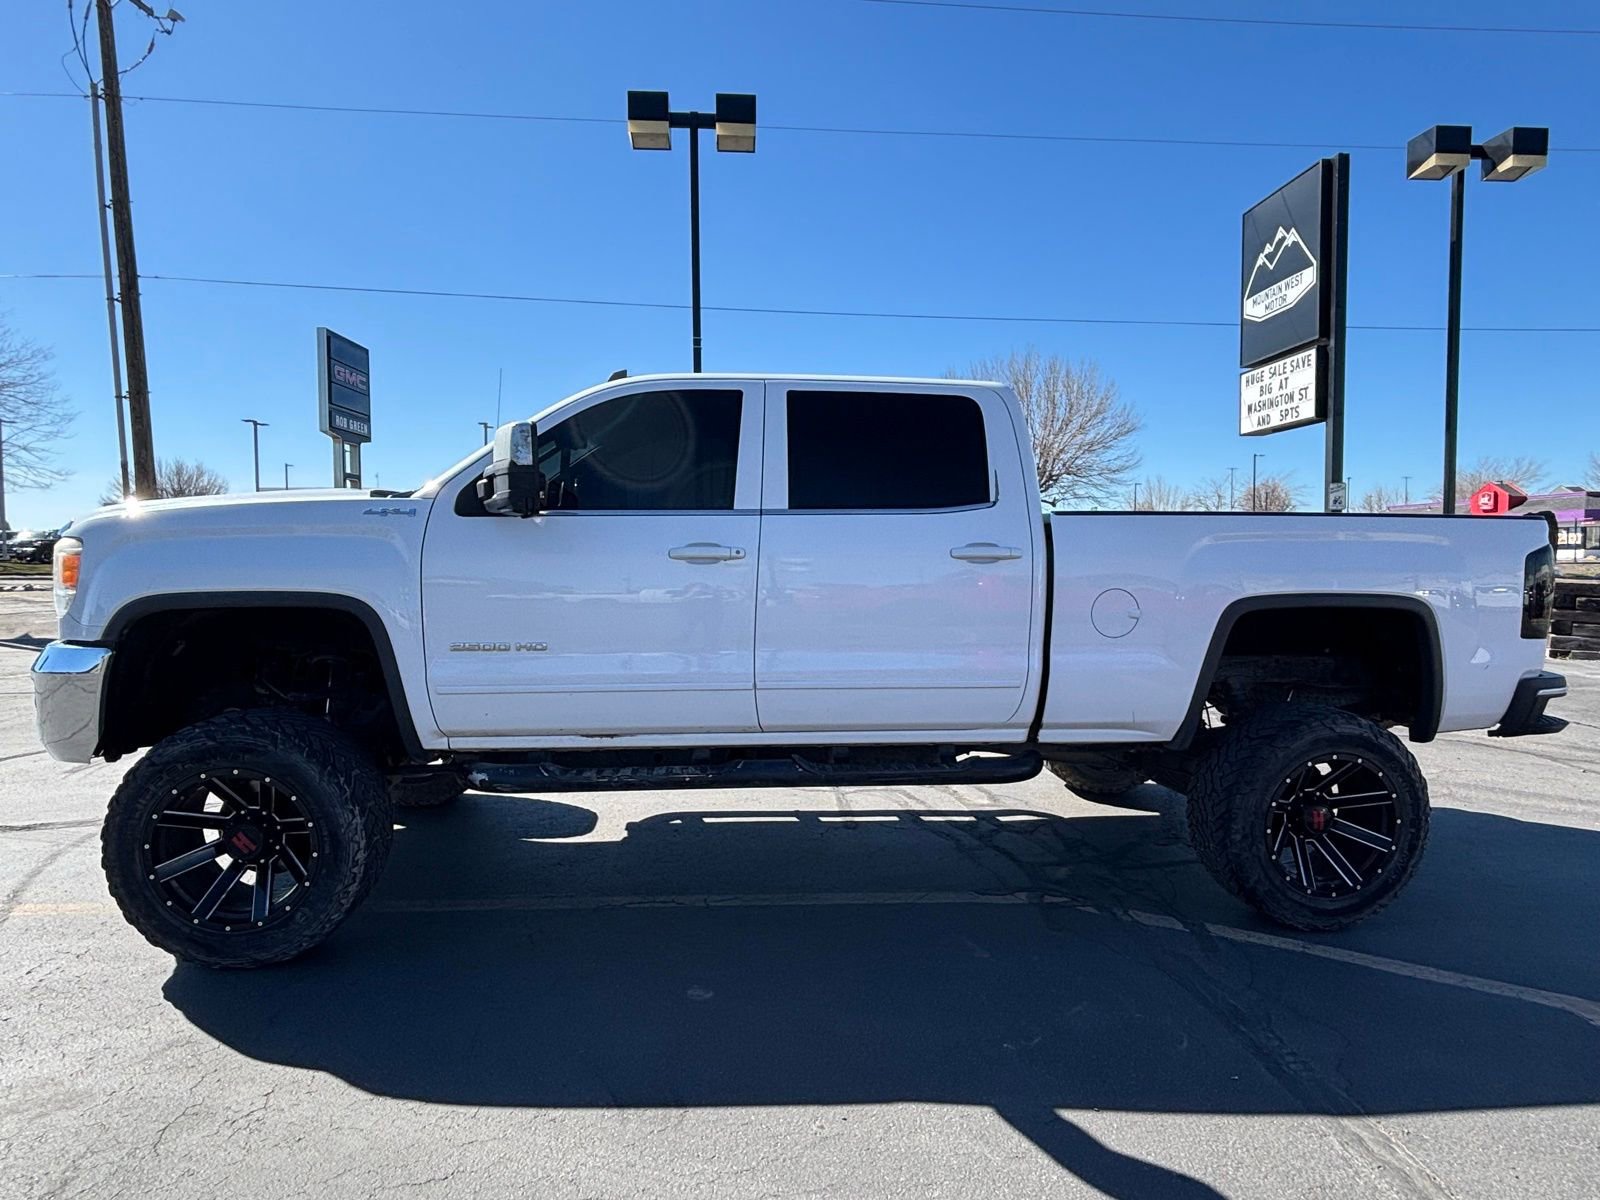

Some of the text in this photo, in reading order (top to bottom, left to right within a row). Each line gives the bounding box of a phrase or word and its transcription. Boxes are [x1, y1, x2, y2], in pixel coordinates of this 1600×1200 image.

[1252, 272, 1304, 308] MOUNTAIN WEST
[1264, 293, 1288, 313] MOTOR
[334, 364, 367, 391] GMC
[1245, 353, 1312, 388] HUGE SALE SAVE
[1259, 376, 1289, 397] BIG AT
[1247, 386, 1309, 416] WASHINGTON ST
[349, 419, 368, 434] GREEN
[1257, 413, 1271, 428] AND
[449, 641, 548, 652] 2500 HD
